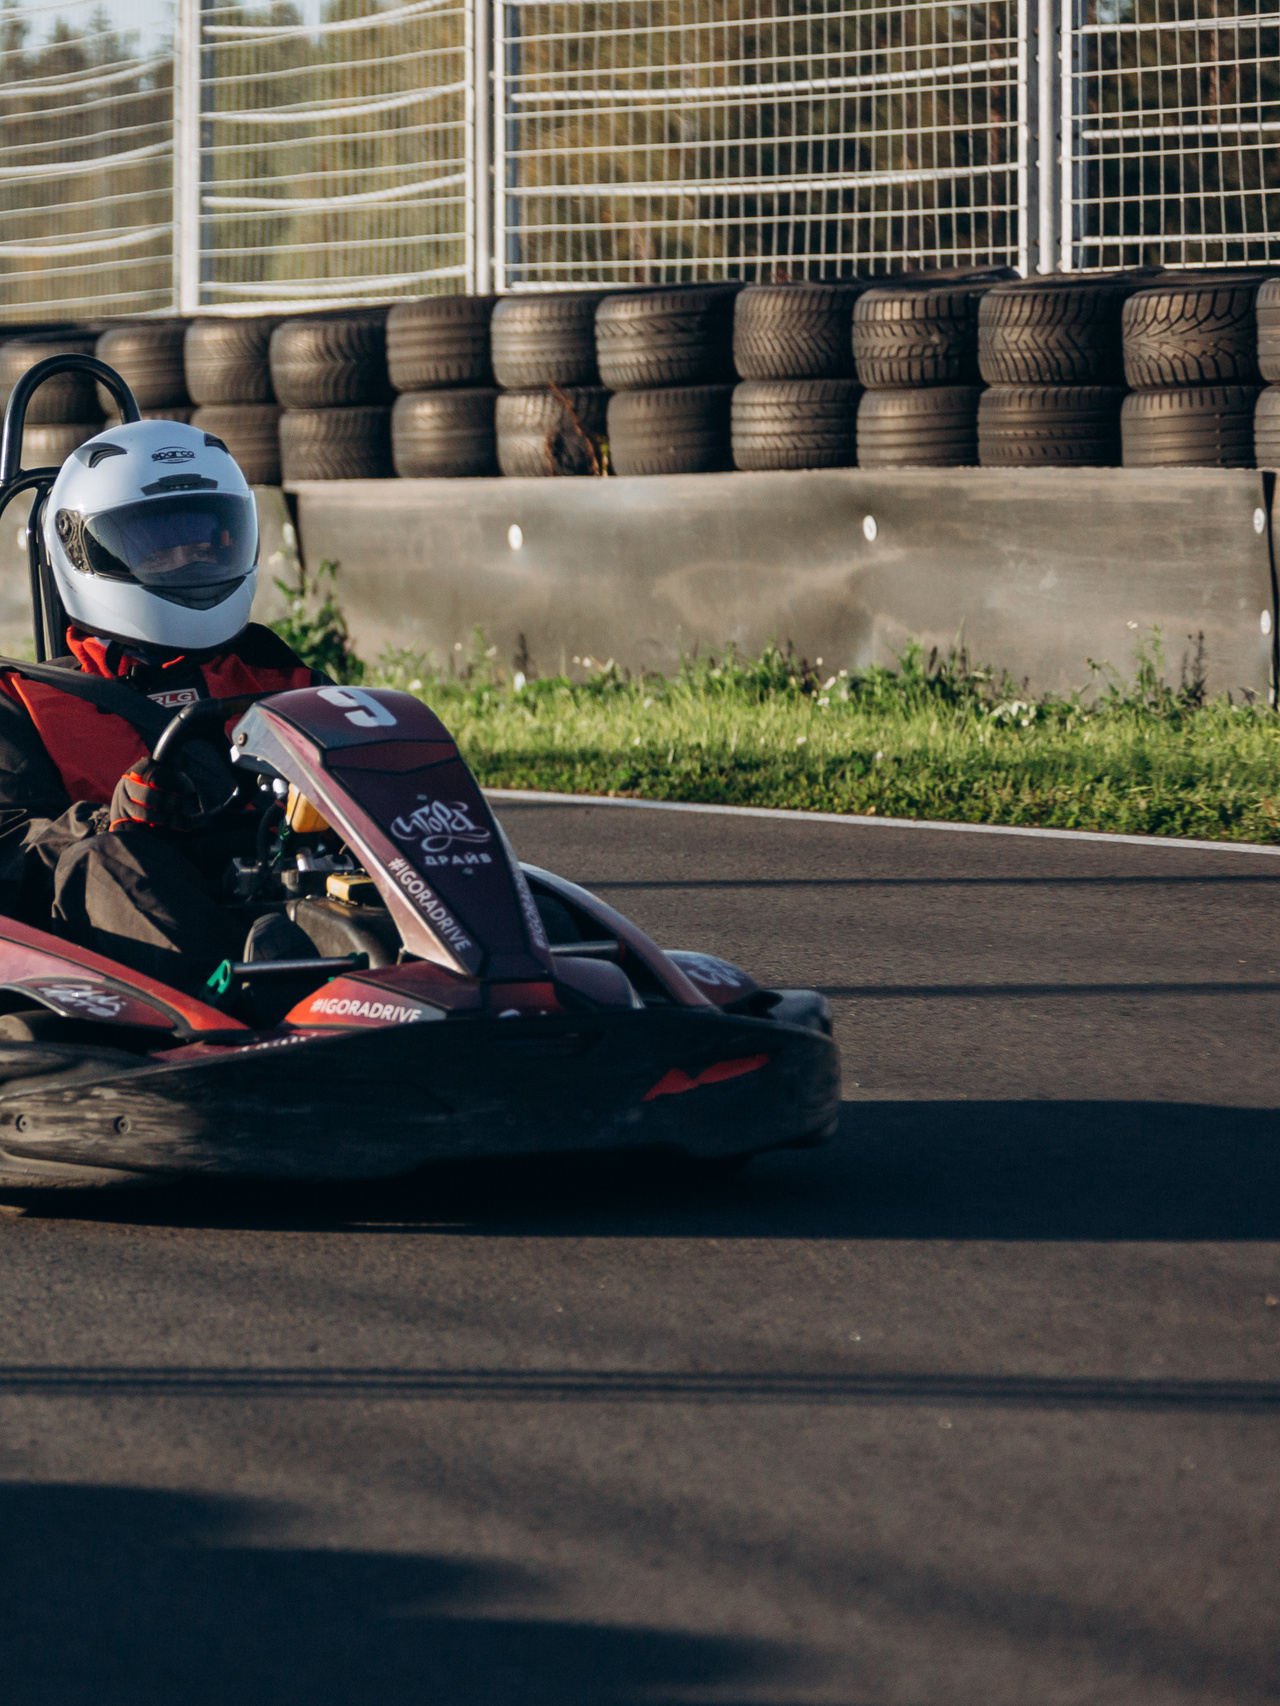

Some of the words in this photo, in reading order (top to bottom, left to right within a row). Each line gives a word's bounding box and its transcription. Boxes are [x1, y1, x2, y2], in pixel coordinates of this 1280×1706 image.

[317, 687, 397, 727] 9
[425, 853, 492, 866] ДРАЙВ
[388, 858, 472, 951] #IGORADRIVE
[310, 998, 422, 1023] #IGORADRIVE
